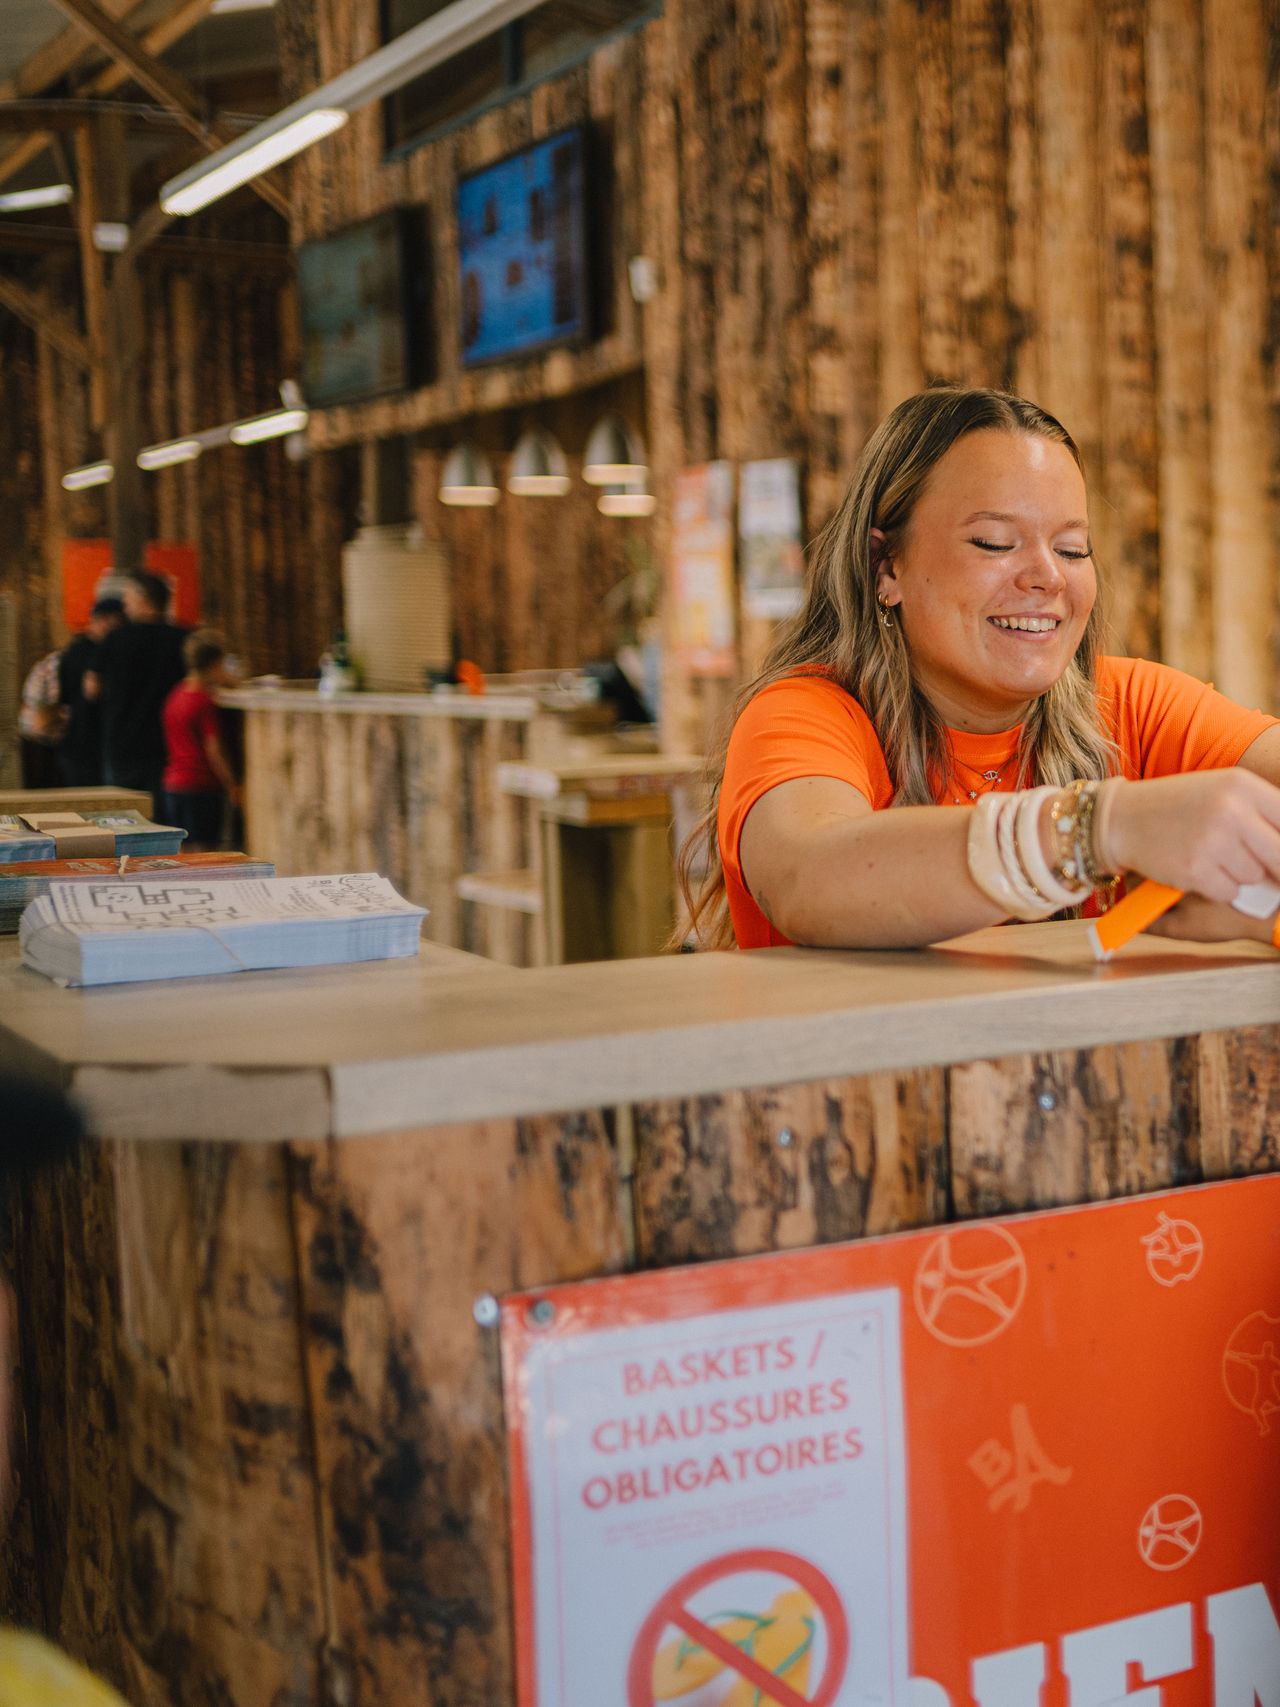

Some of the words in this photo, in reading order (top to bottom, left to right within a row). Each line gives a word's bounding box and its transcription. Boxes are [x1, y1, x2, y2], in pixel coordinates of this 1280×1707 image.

[622, 1336, 797, 1397] BASKETS
[807, 1329, 826, 1371] /
[592, 1378, 850, 1455] CHAUSSURES
[581, 1427, 864, 1510] OBLIGATOIRES
[967, 1402, 1073, 1512] BA
